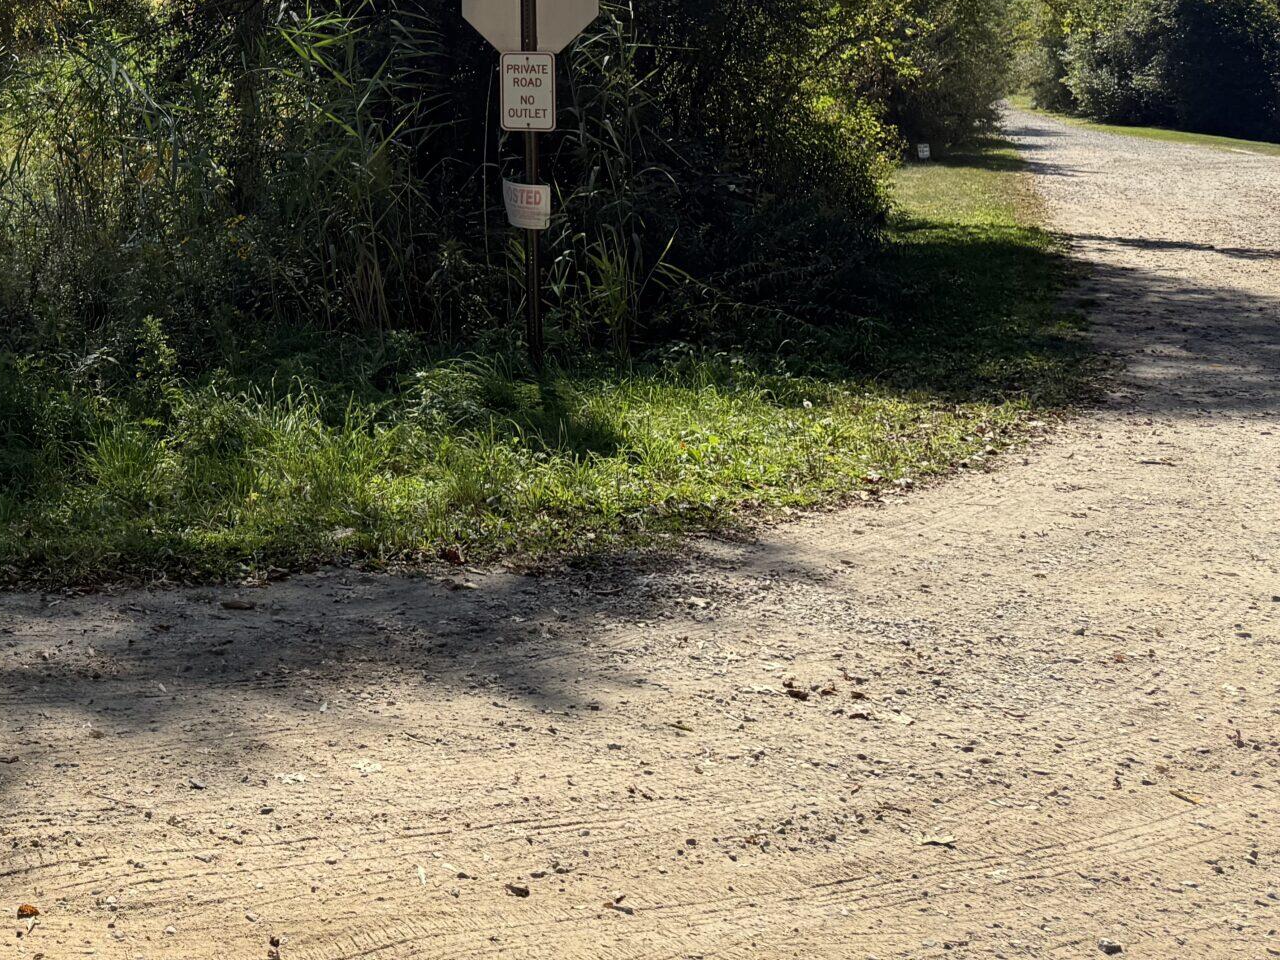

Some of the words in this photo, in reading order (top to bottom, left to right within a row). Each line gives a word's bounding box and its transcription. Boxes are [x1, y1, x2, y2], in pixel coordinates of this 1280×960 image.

[506, 64, 548, 74] PRIVATE
[513, 77, 542, 87] ROAD
[520, 95, 535, 105] NO
[508, 108, 547, 119] OUTLET
